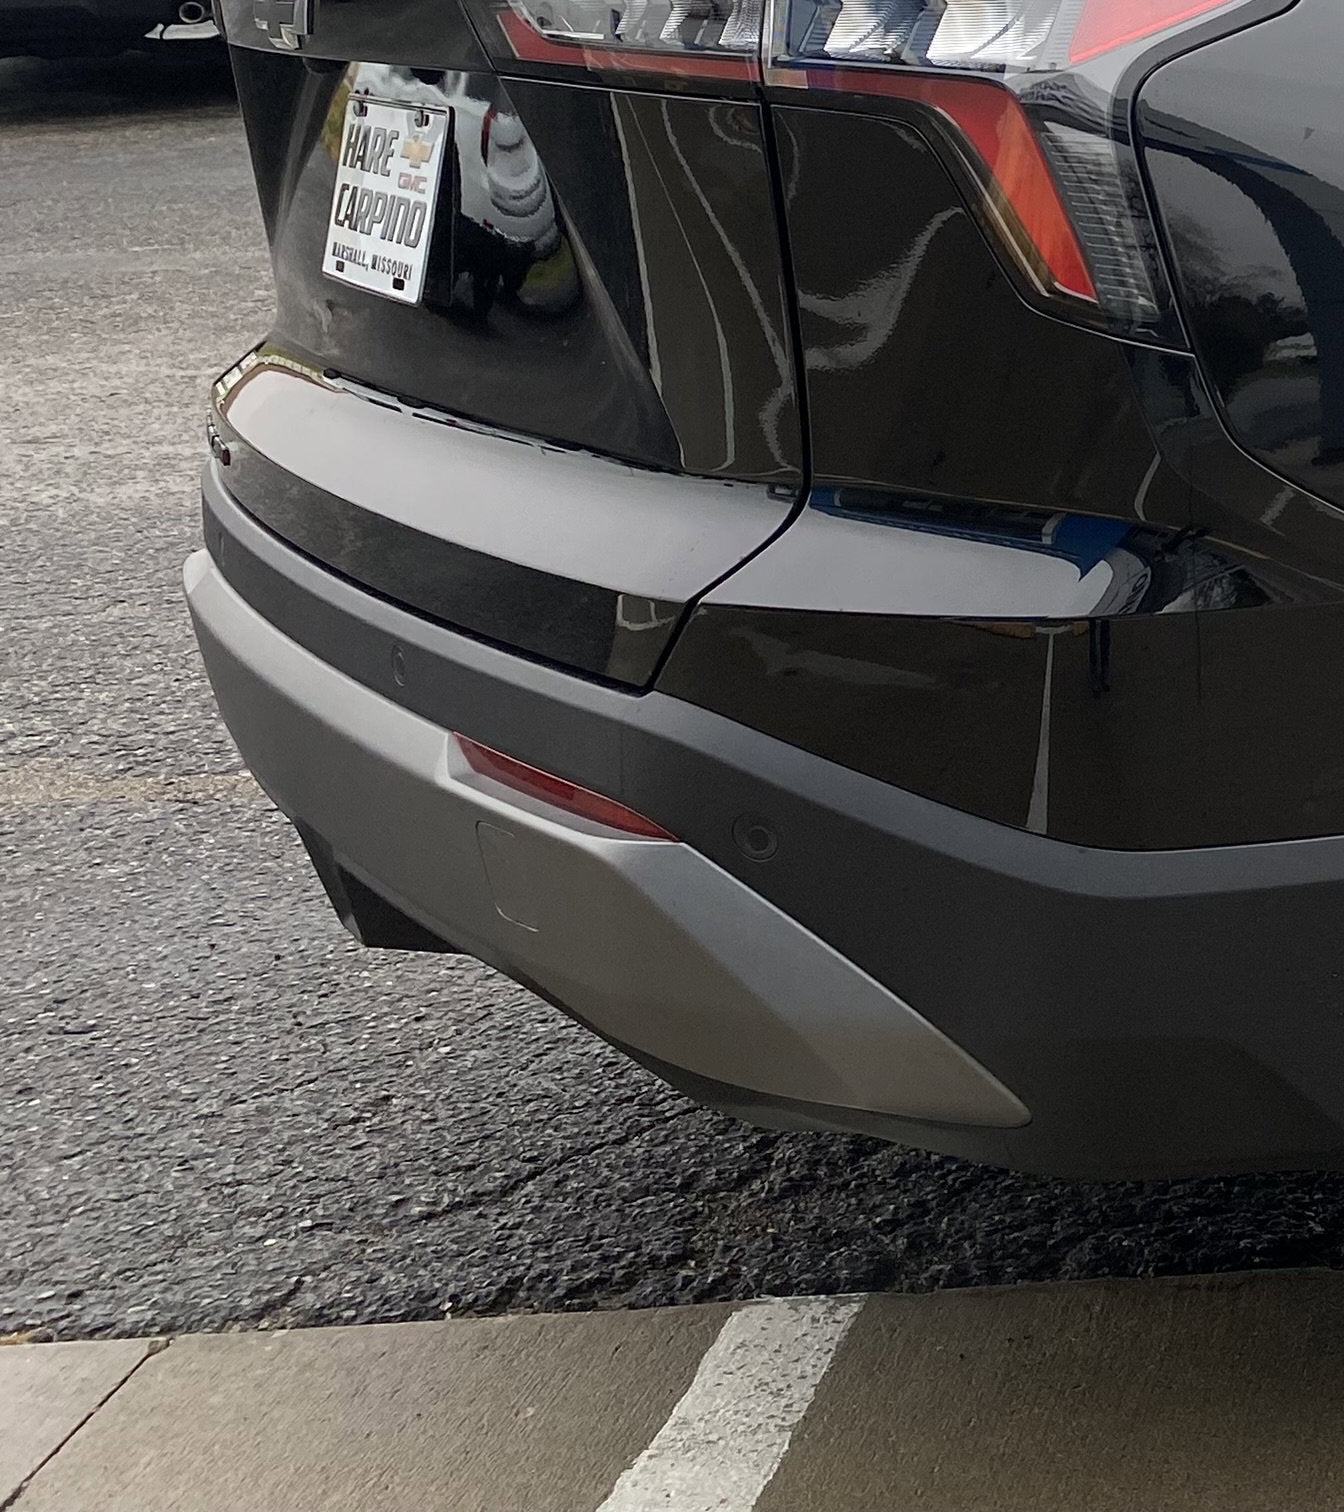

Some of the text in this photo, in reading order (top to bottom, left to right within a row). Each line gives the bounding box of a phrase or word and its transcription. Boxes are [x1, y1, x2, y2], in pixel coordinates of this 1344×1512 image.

[342, 124, 399, 177] HARE
[398, 172, 427, 194] GMC
[335, 184, 427, 248] CARPINO
[371, 254, 414, 280] MISSOURI
